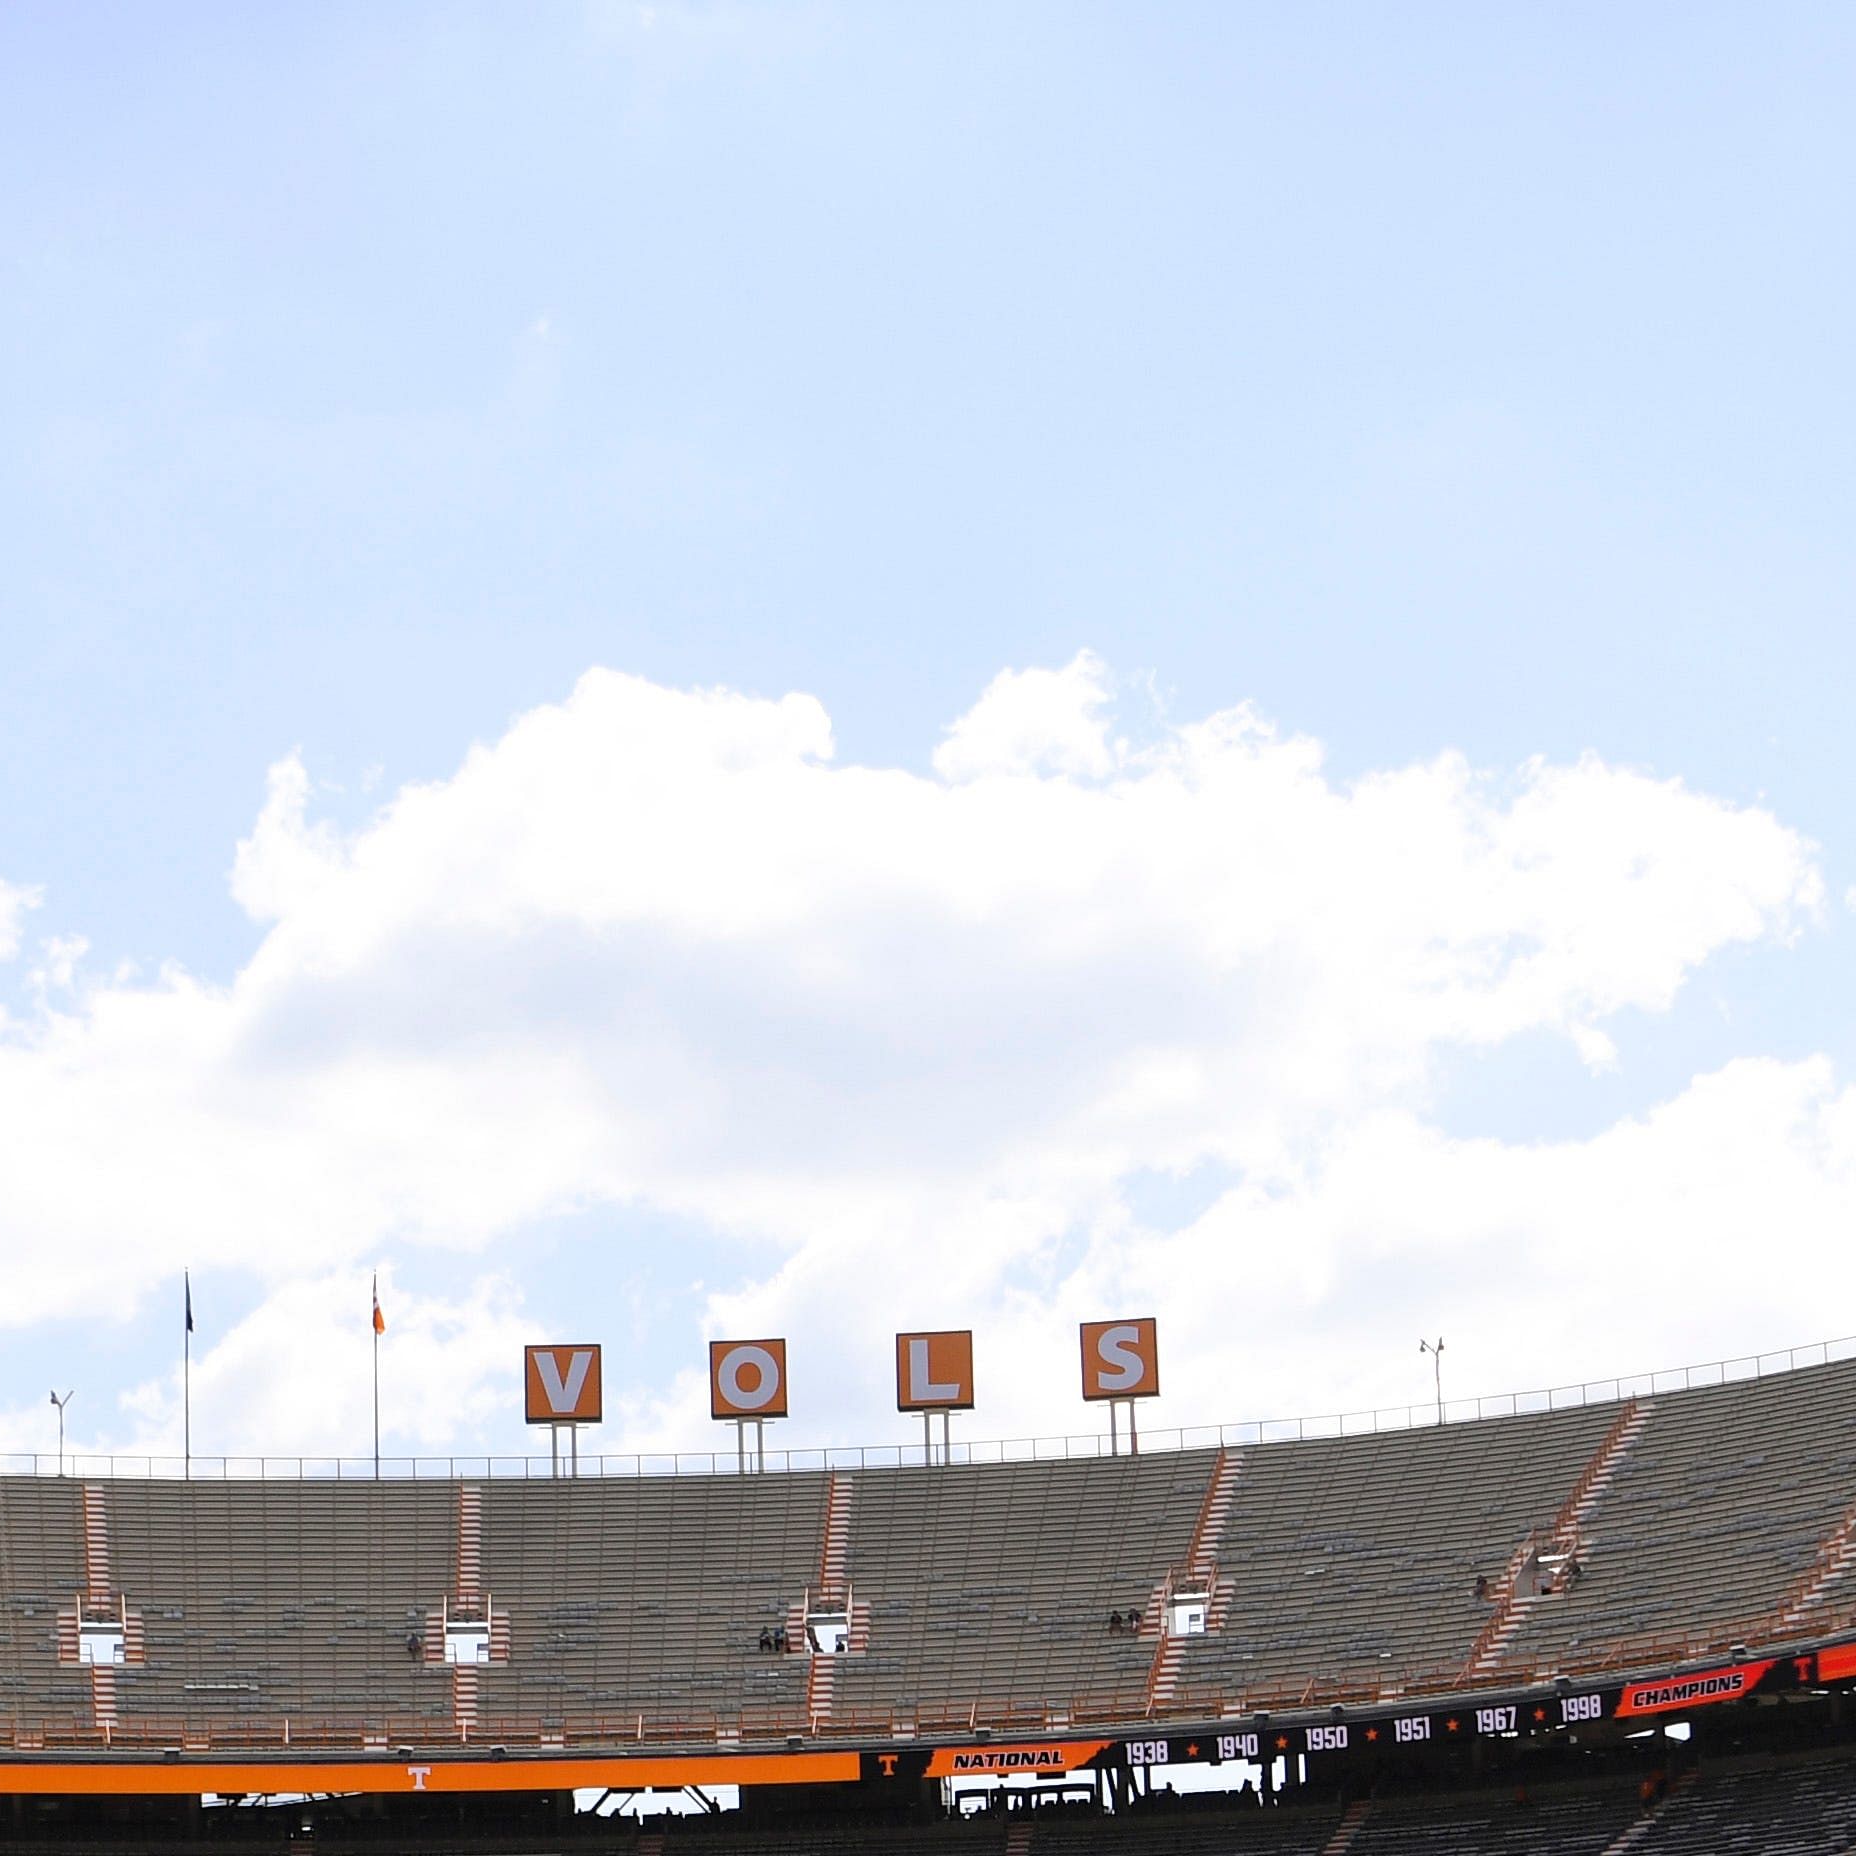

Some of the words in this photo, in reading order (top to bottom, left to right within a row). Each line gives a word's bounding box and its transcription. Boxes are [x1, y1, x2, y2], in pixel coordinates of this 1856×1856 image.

[1630, 1674, 1744, 1709] CHAMPIONS
[1124, 1740, 1168, 1765] 1938
[1216, 1733, 1259, 1760] 1940
[1305, 1725, 1348, 1752] 1950
[1393, 1716, 1431, 1742] 1951
[1475, 1706, 1518, 1733] 1967
[1561, 1694, 1602, 1722] 1998
[952, 1750, 1064, 1769] NATIONAL
